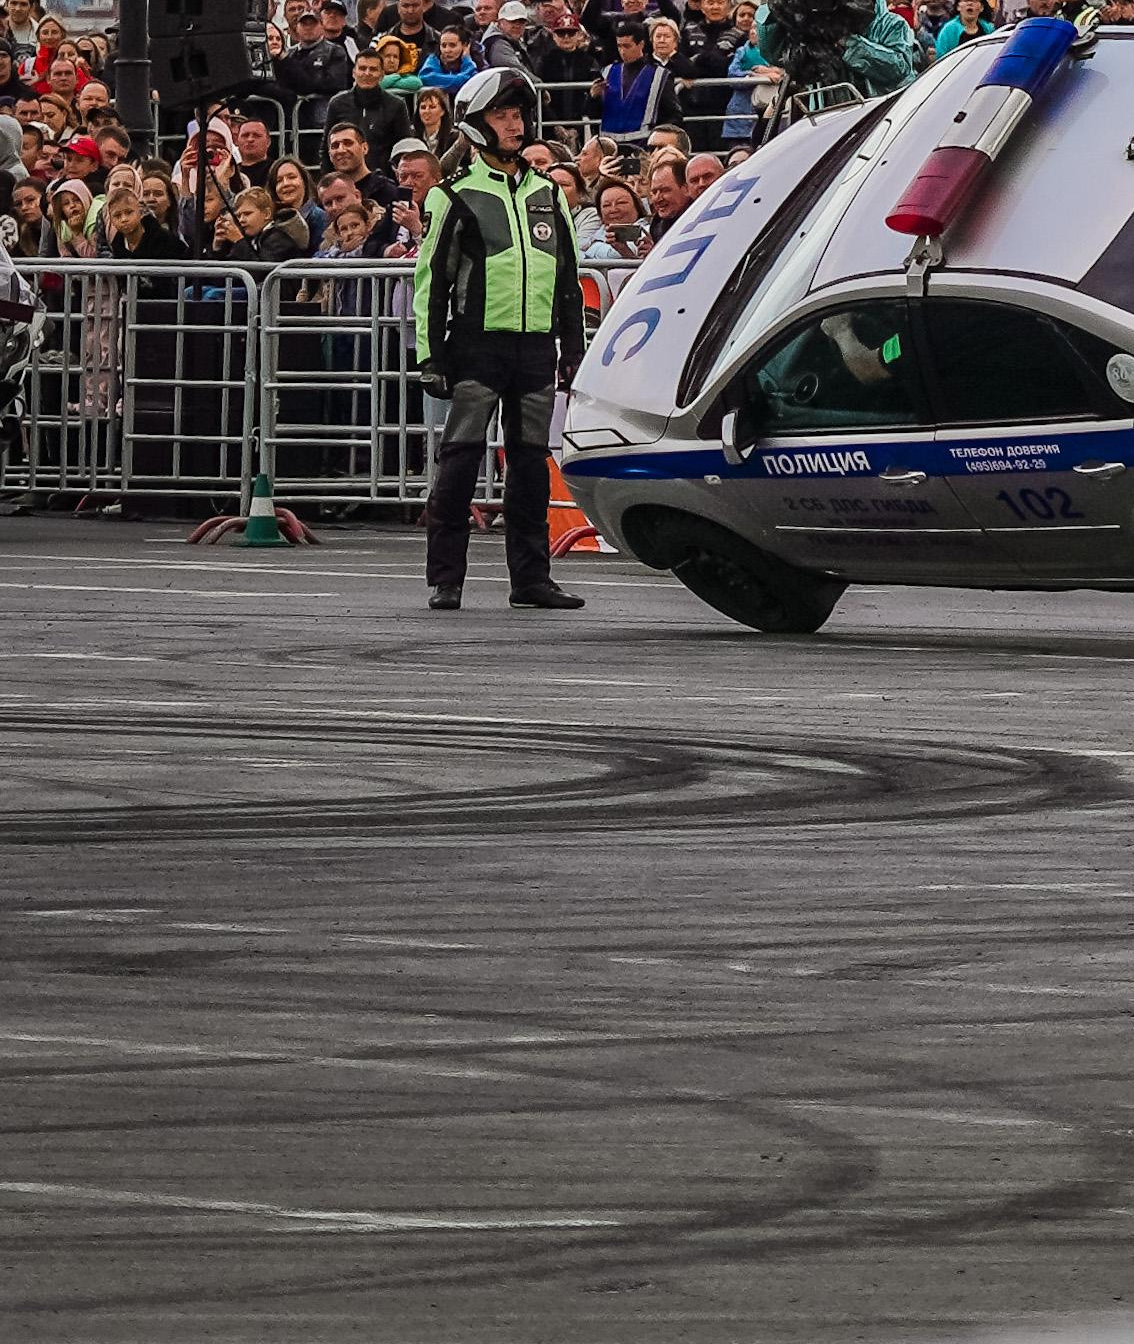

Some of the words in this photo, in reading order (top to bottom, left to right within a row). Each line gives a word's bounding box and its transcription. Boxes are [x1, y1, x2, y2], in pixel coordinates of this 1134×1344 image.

[602, 174, 761, 366] ДПС
[762, 450, 871, 475] ПОЛИЦИЯ
[949, 447, 1004, 459] ТЕЛЕФОН
[1006, 444, 1061, 458] ДОВЕРИЯ
[995, 486, 1086, 521] 102
